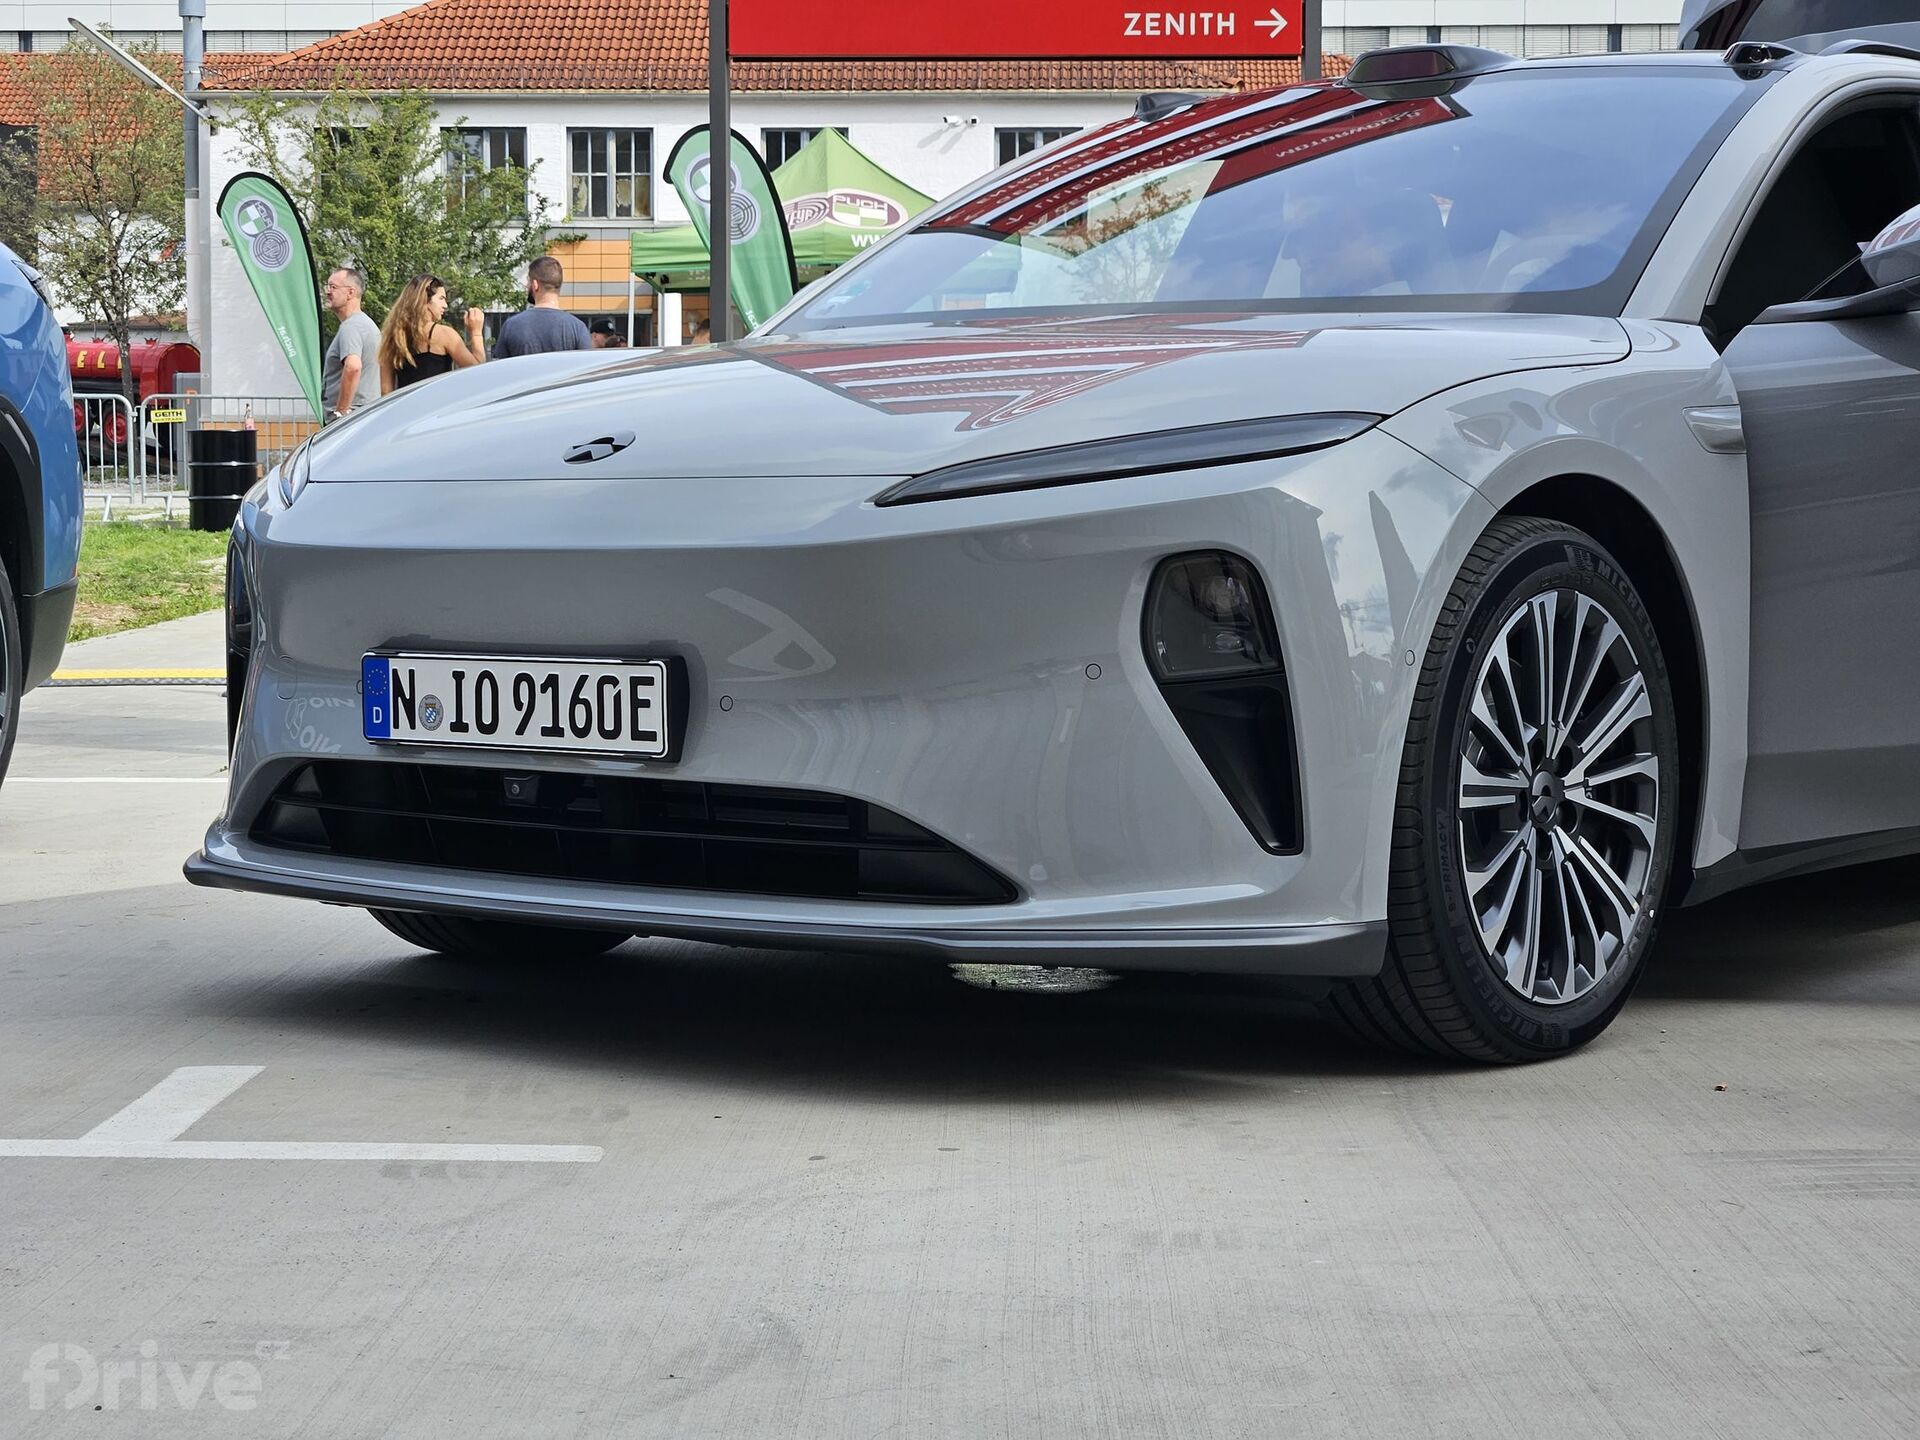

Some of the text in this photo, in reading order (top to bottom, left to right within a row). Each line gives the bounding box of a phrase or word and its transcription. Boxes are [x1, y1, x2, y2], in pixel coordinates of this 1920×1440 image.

[1123, 12, 1235, 36] ZENITH
[833, 195, 888, 211] PUCH
[372, 706, 384, 724] D
[392, 668, 417, 731] N
[450, 669, 500, 736] IO
[512, 671, 658, 742] 9160E
